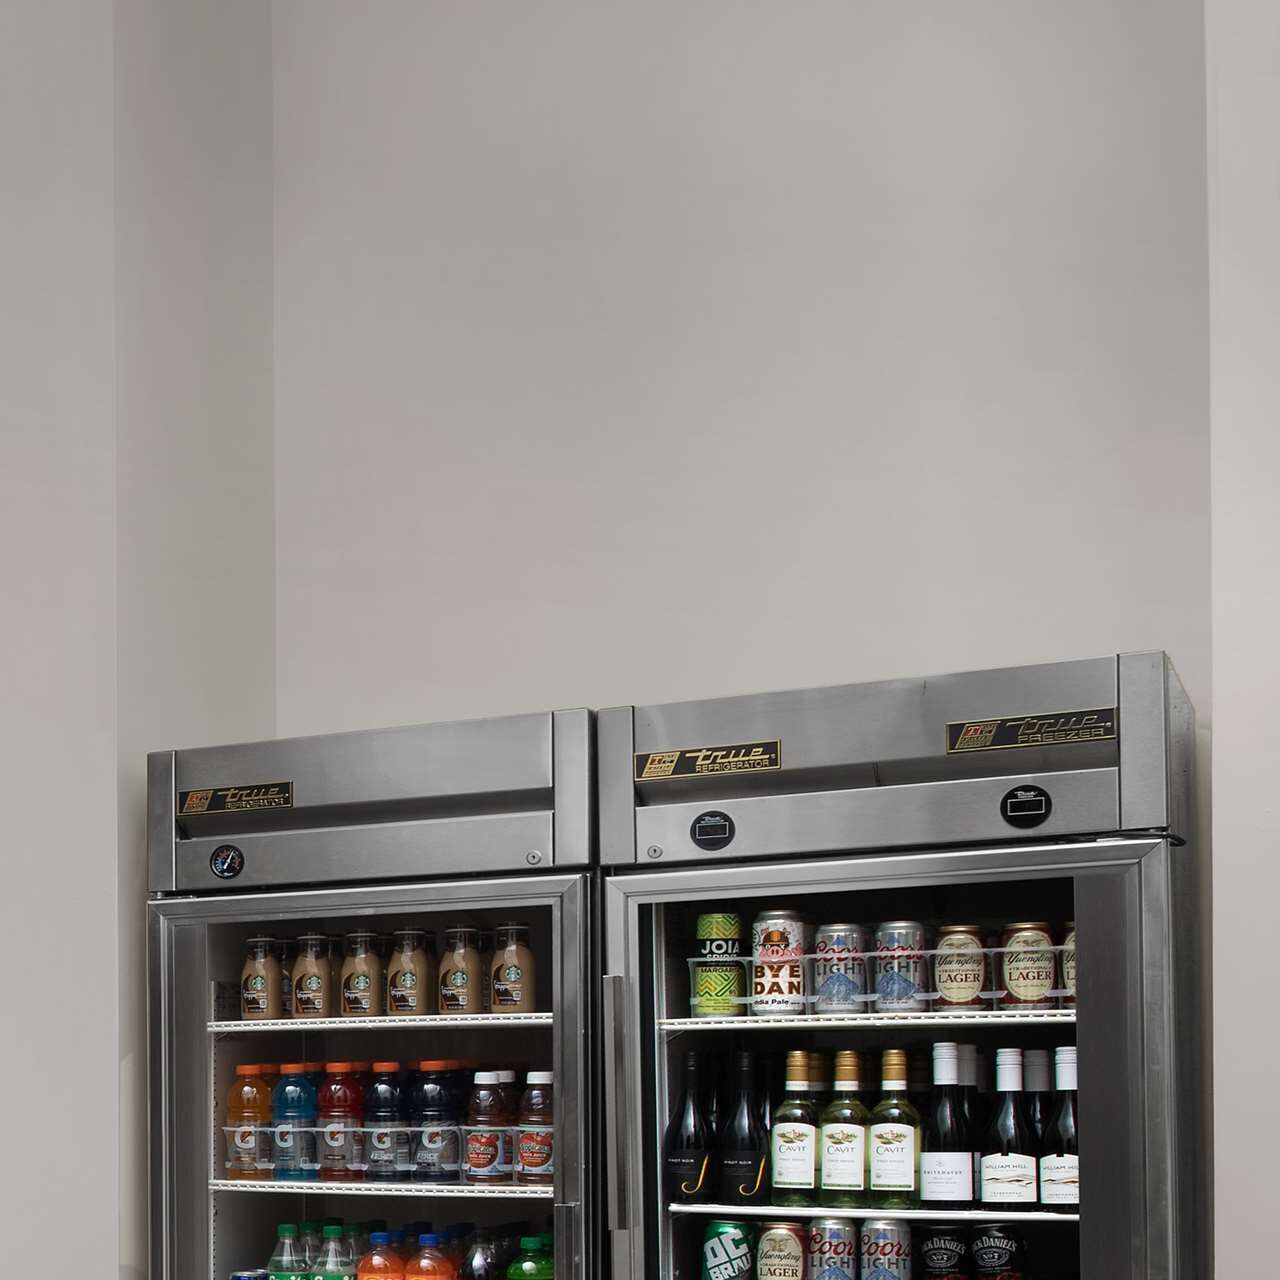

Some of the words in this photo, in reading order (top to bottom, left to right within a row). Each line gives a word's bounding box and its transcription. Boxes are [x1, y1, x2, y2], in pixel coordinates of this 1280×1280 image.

[1017, 728, 1104, 743] FREEZER
[695, 759, 769, 773] REFRIGERATOR
[701, 940, 740, 955] JOIA
[937, 953, 982, 967] Yuengling
[1007, 952, 1052, 965] Yuengling
[754, 964, 801, 979] BYE
[817, 963, 865, 976] LIGHT
[1008, 970, 1052, 982] LAGER
[938, 972, 981, 984] LAGER
[753, 981, 801, 995] DAN
[779, 1144, 807, 1154] CAVIT
[876, 1146, 904, 1155] CAVIT
[704, 1228, 749, 1269] DC
[861, 1234, 911, 1257] Coors
[933, 1237, 966, 1255] DANIEL'S
[982, 1236, 1017, 1252] DANIEL'S
[759, 1250, 800, 1262] Yuengling
[862, 1258, 908, 1269] LIGHT
[759, 1267, 799, 1278] LAGER
